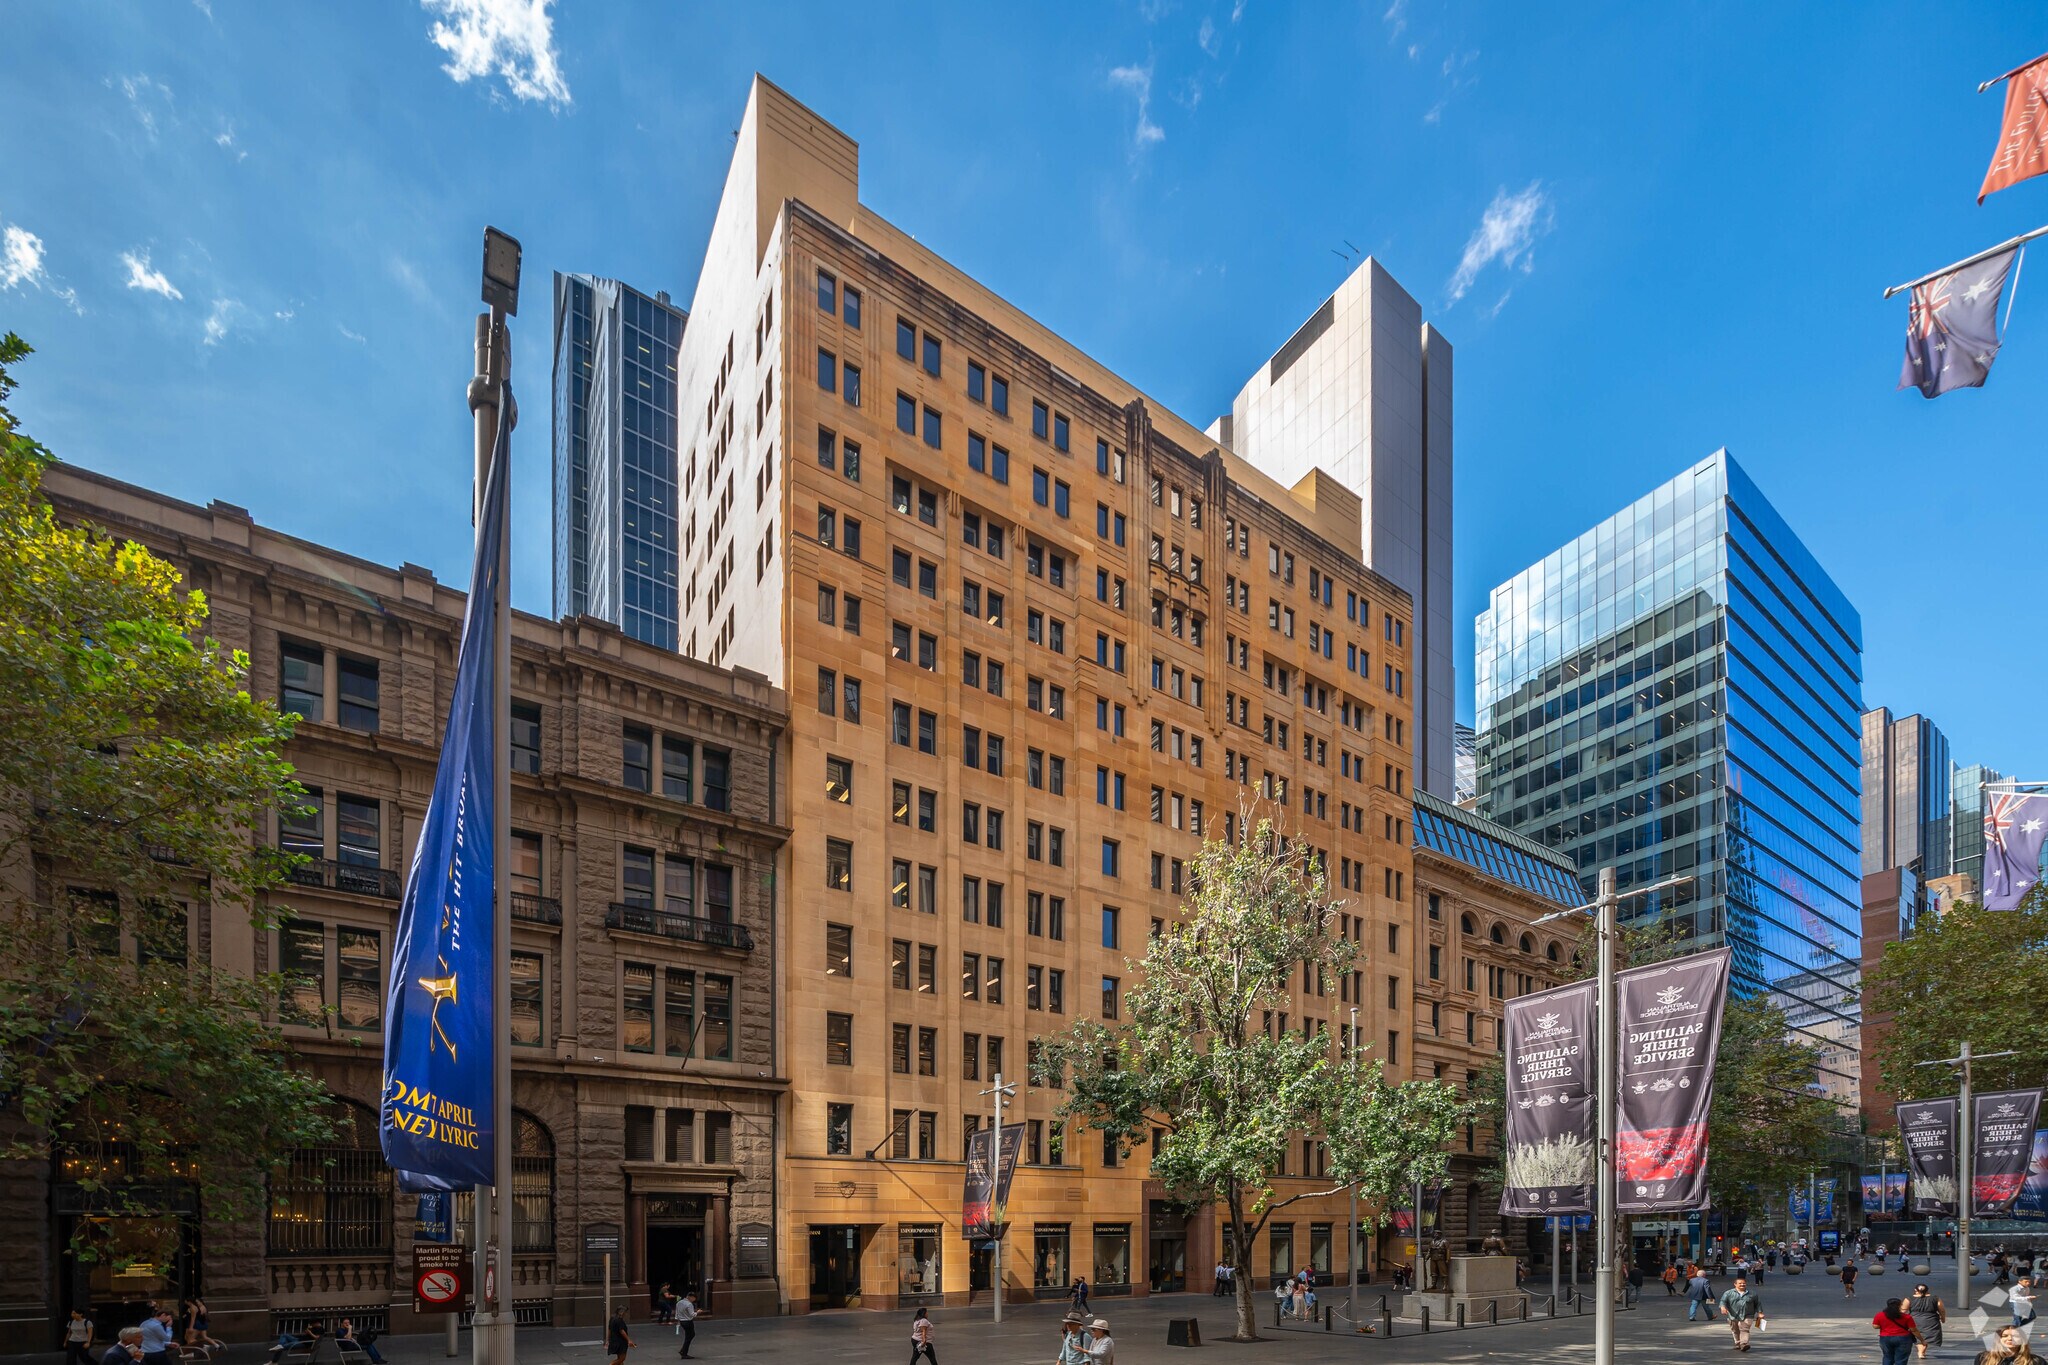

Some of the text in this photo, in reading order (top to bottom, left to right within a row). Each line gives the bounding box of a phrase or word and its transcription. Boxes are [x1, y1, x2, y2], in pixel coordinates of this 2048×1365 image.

[1992, 138, 2024, 176] THE
[453, 852, 463, 898] HIT
[451, 907, 461, 951] THE
[438, 1099, 477, 1128] APRIL
[440, 1122, 479, 1150] LYRIC
[418, 1255, 441, 1263] proud
